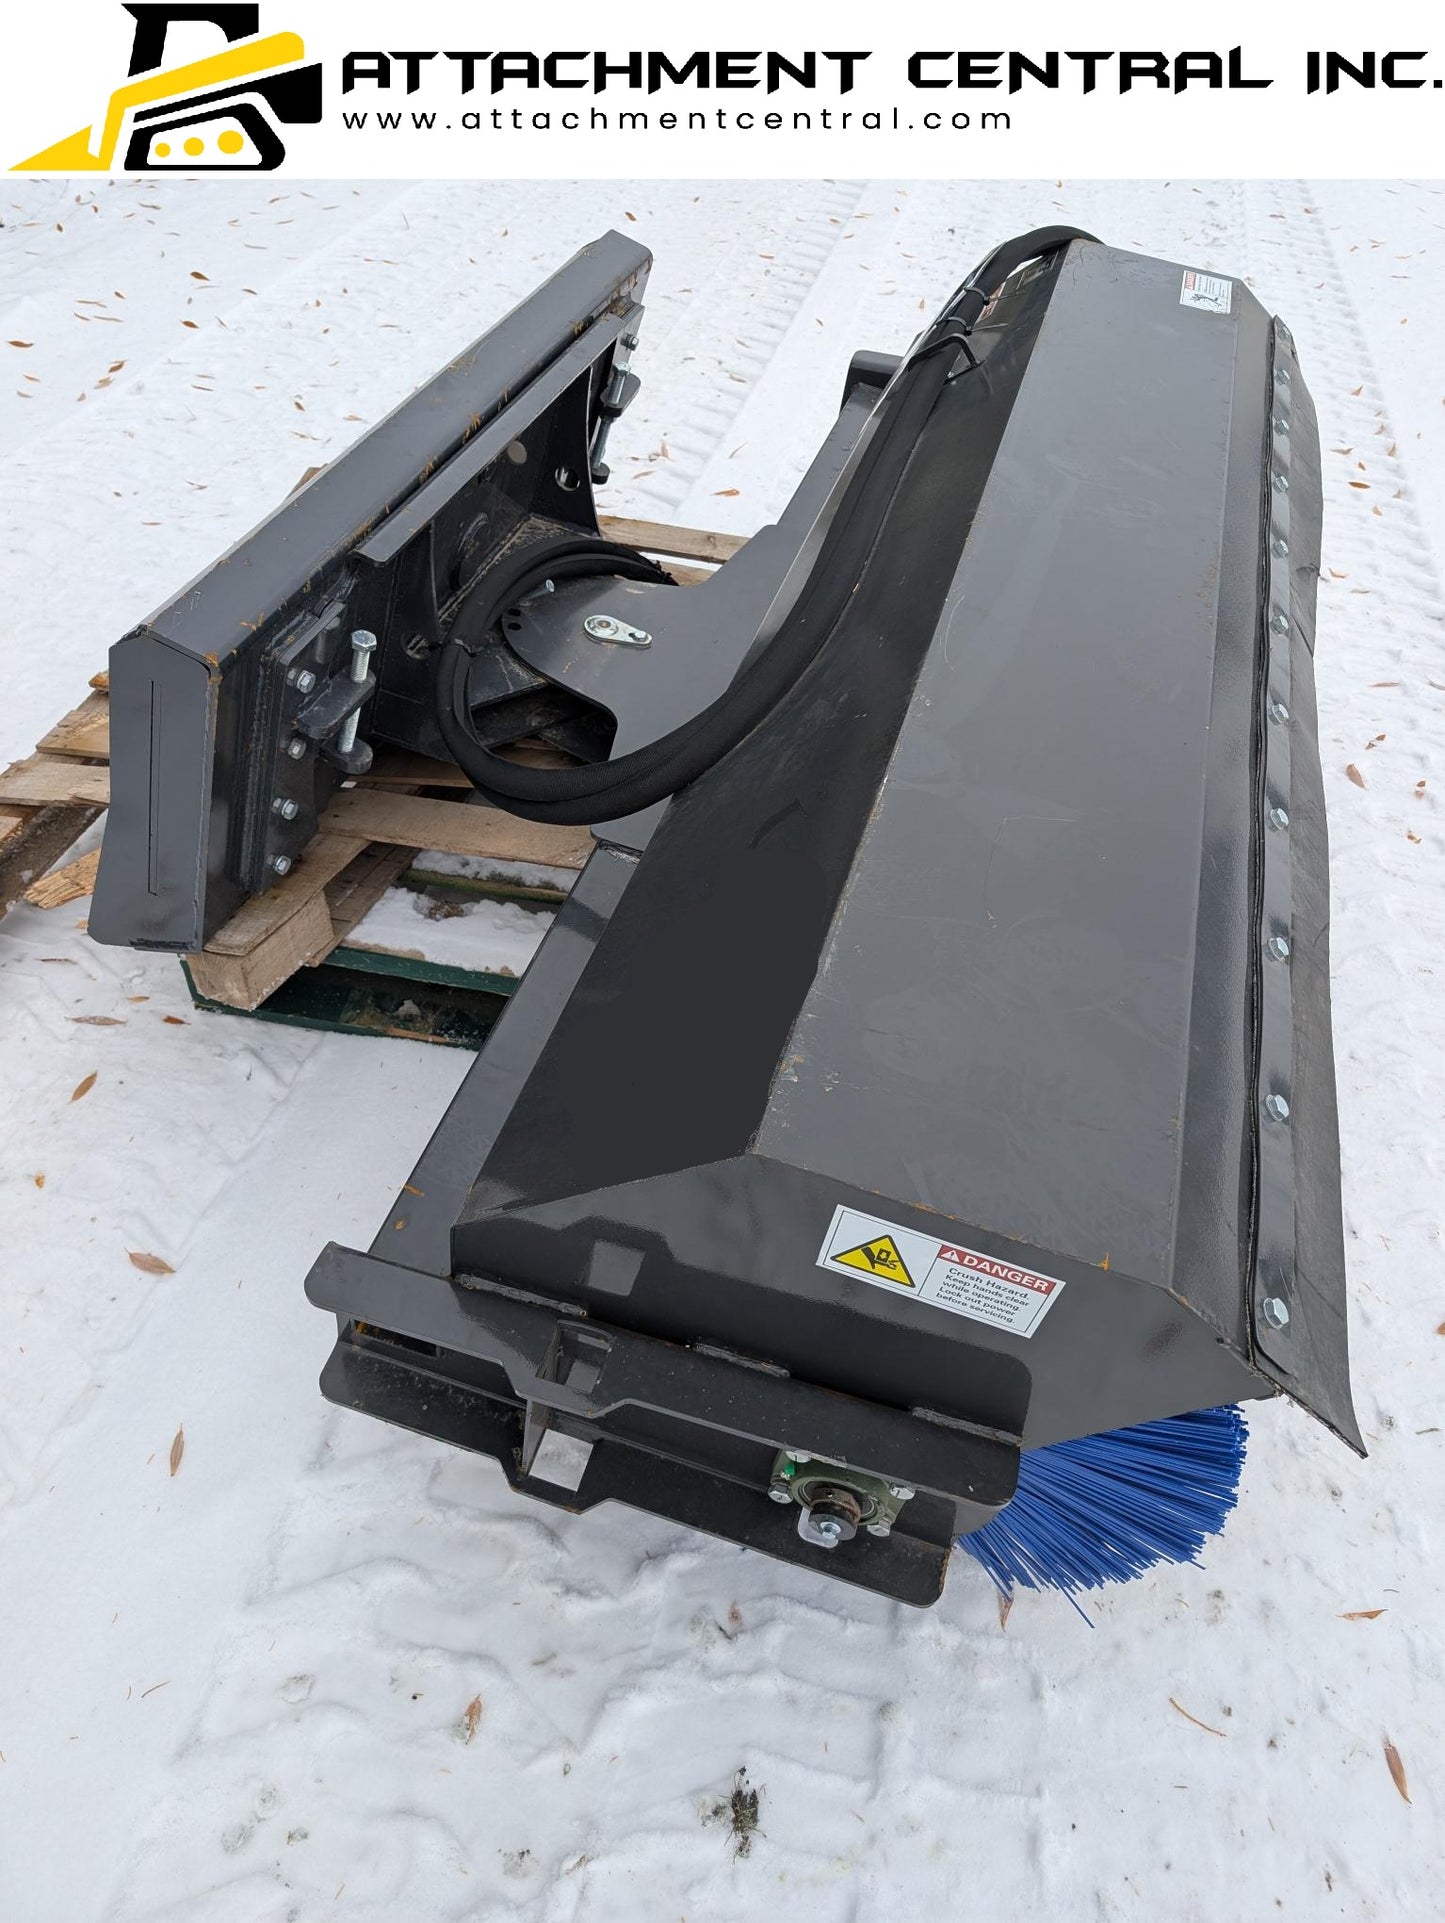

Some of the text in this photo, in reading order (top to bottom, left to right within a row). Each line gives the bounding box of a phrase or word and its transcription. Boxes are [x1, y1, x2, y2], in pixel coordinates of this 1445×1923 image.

[942, 1281, 969, 1293] while
[949, 1267, 1030, 1300] Crush Hazard.
[963, 1255, 1048, 1291] DANGER
[939, 1287, 962, 1299] Lock
[965, 1296, 981, 1304] out
[945, 1275, 1030, 1306] Keep hands clear
[936, 1293, 1015, 1324] before servicing.
